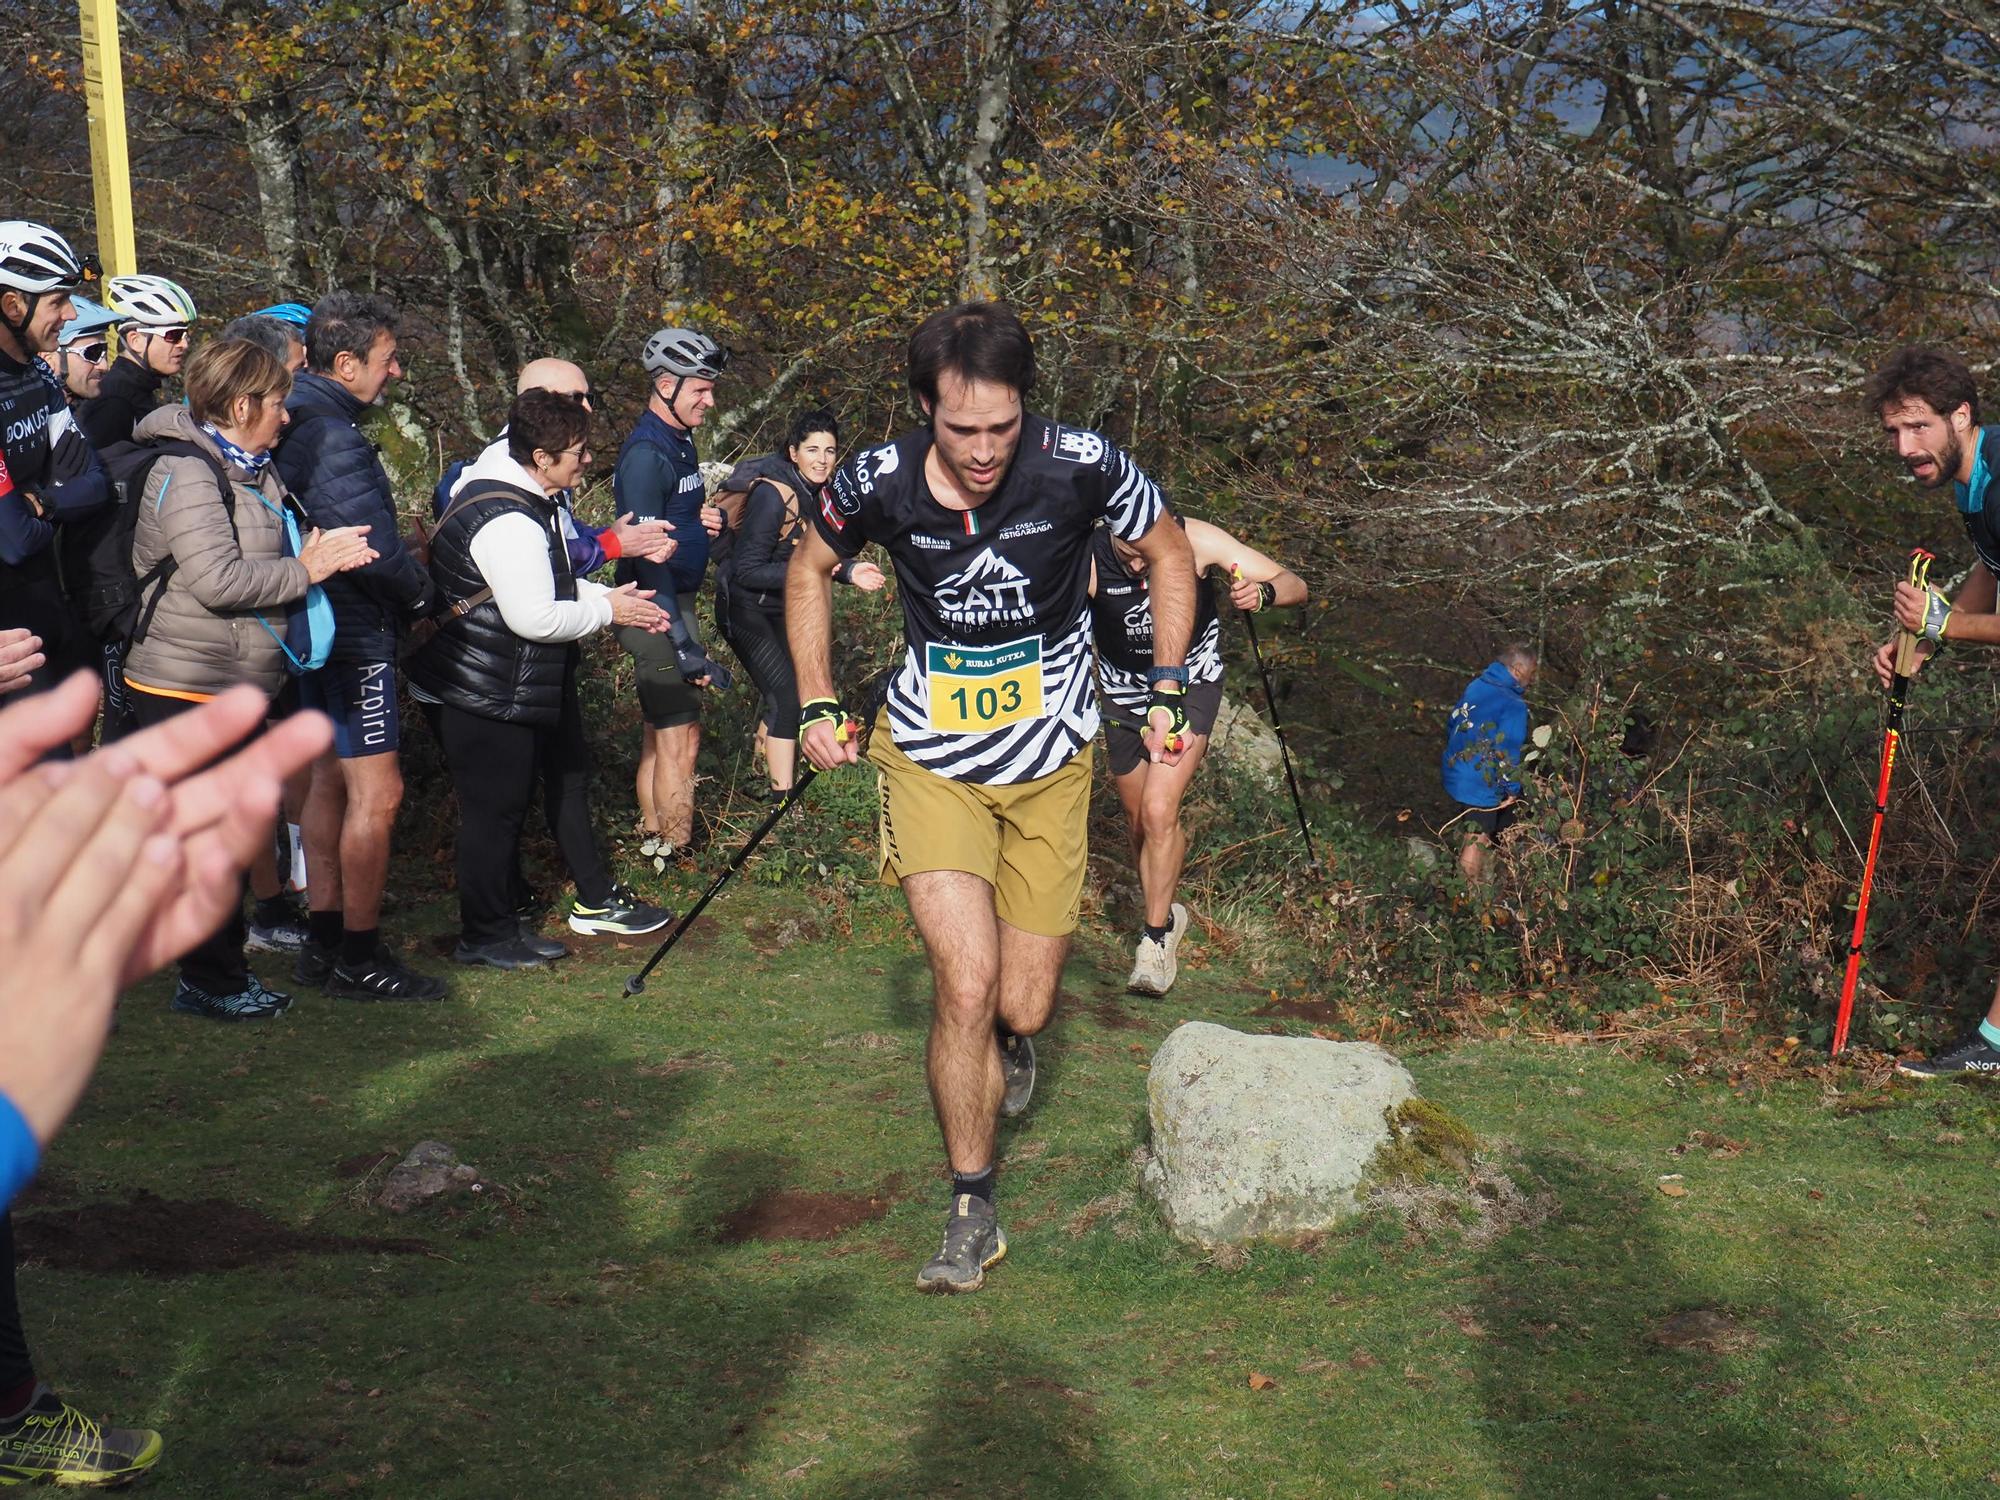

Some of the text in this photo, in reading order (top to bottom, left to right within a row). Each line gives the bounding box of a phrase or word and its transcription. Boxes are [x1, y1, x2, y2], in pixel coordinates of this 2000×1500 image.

[999, 523, 1053, 541] ASTIGARRAGA
[1015, 521, 1034, 530] CASA
[934, 578, 1031, 611] CATT
[1123, 611, 1152, 628] CA
[965, 651, 1026, 668] RURAL KUTXA
[950, 679, 1022, 720] 103
[12, 1441, 80, 1460] SPORTIVA
